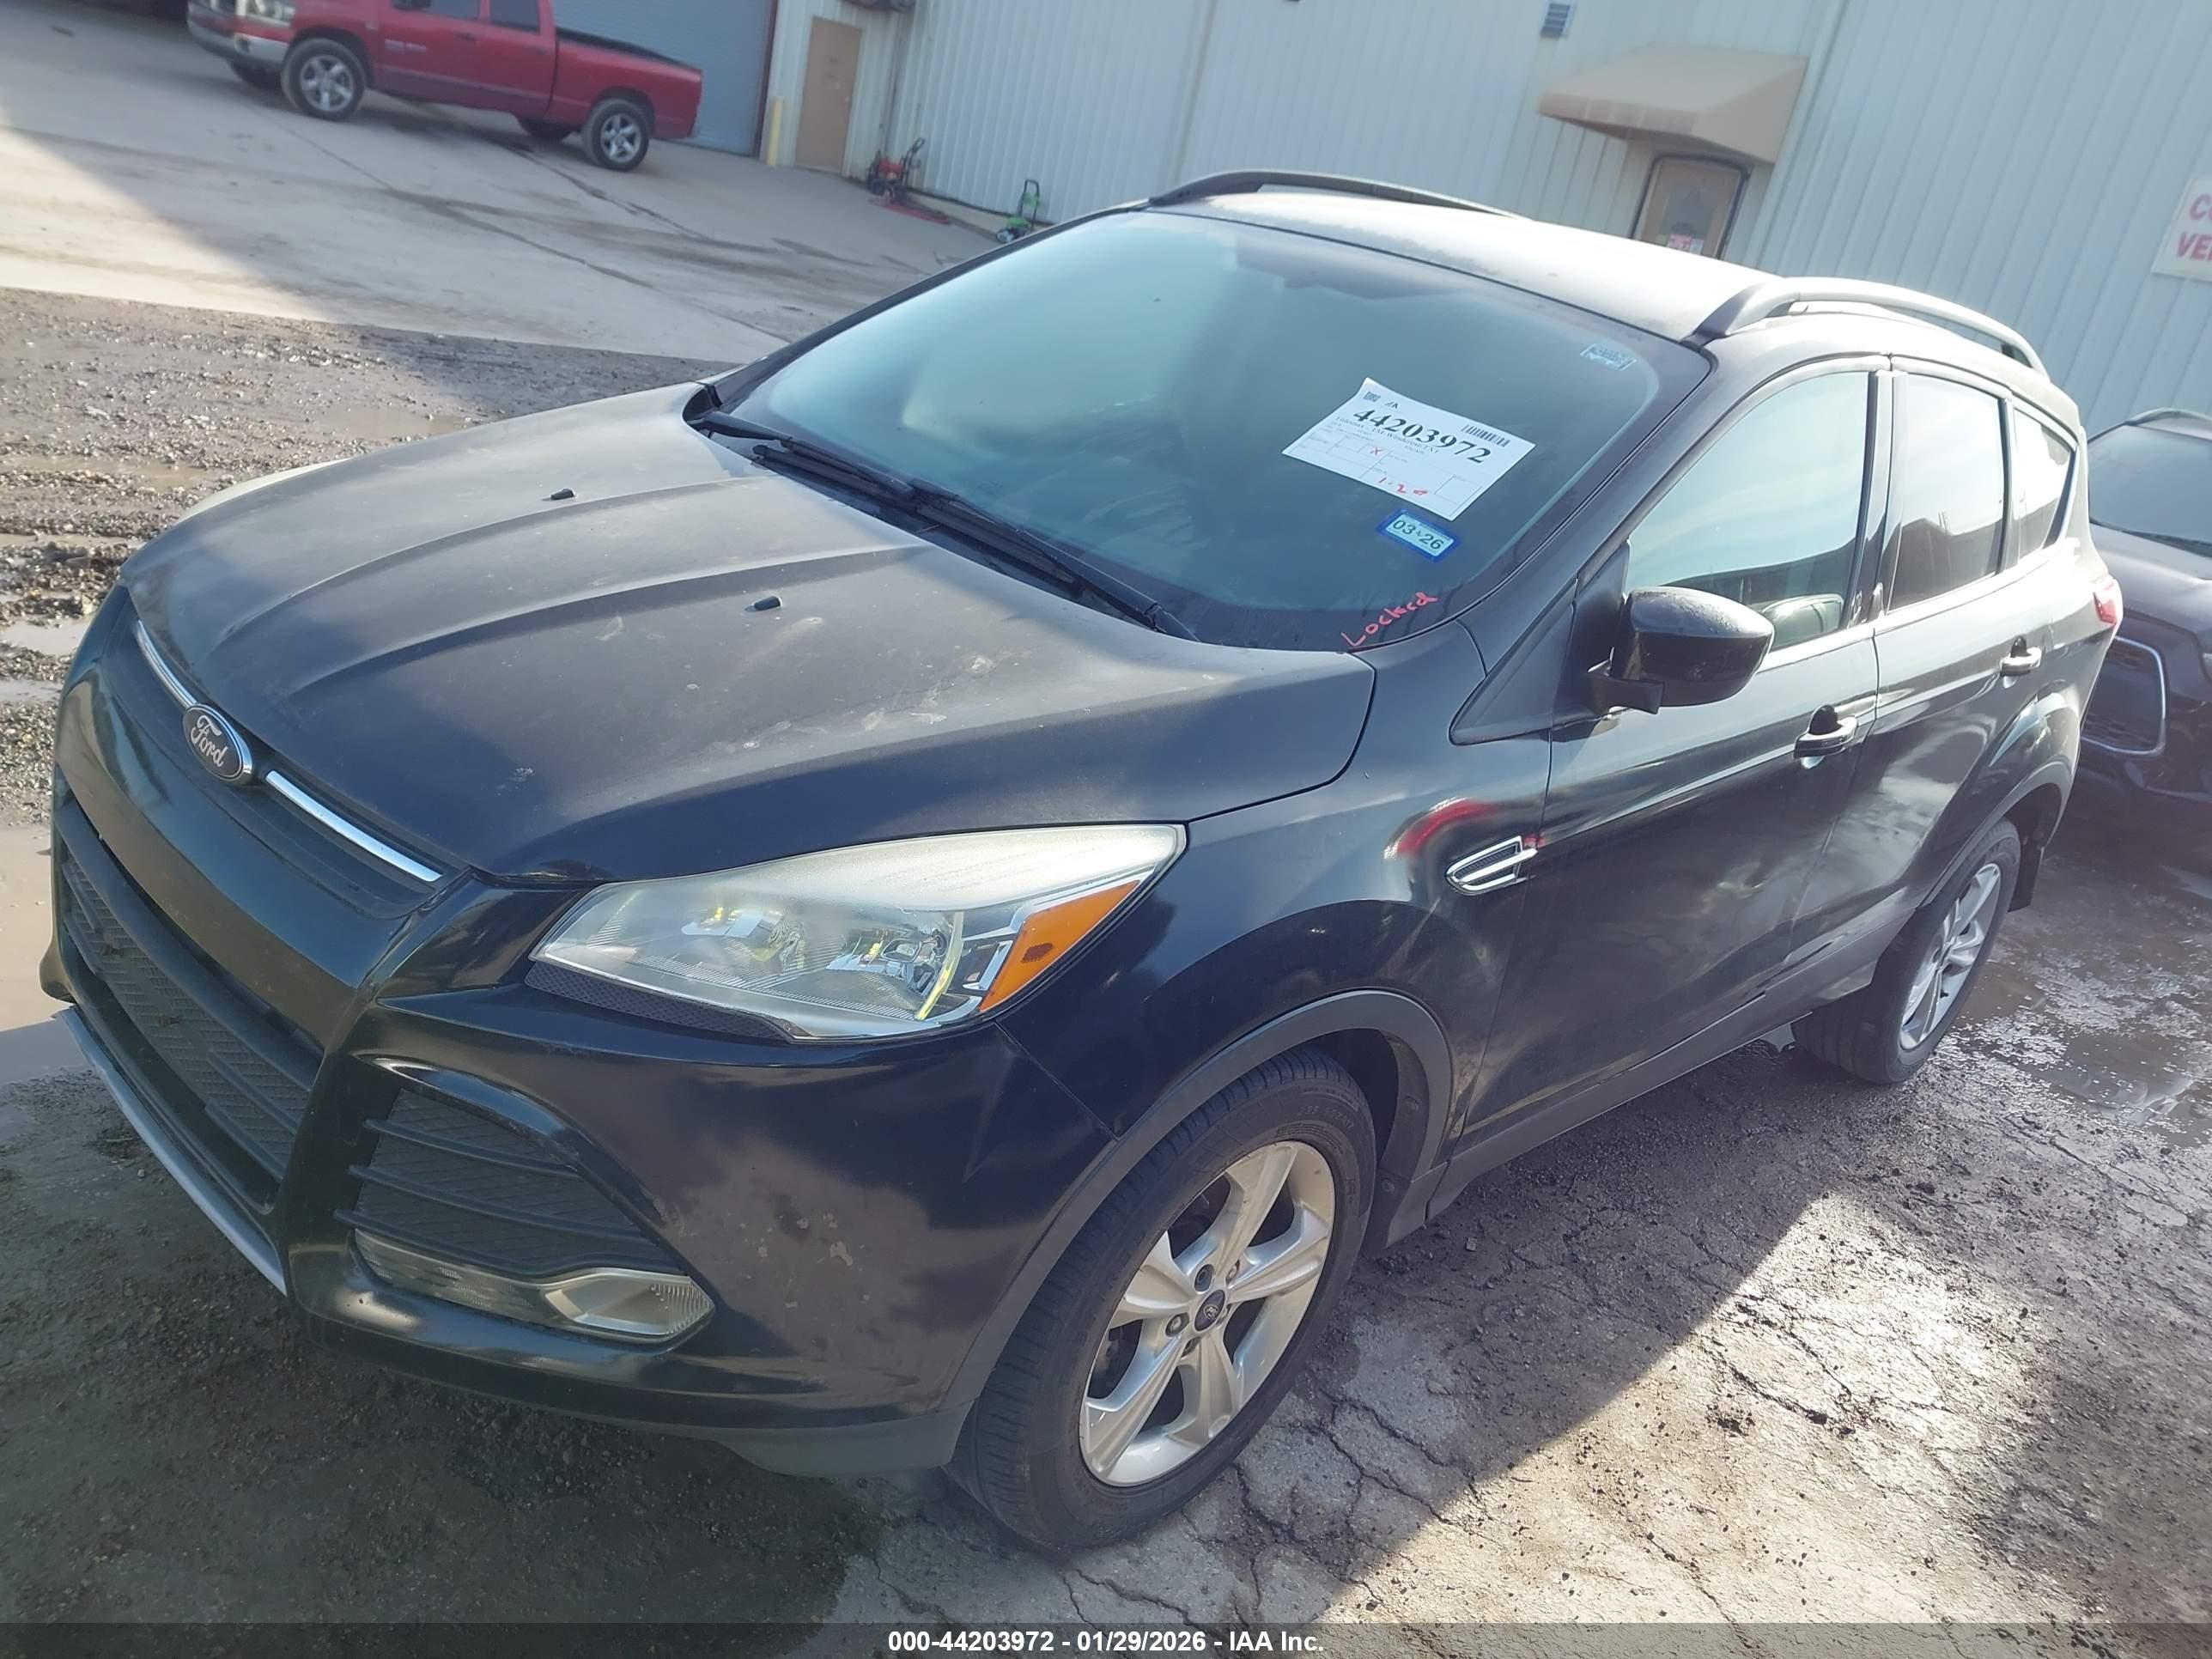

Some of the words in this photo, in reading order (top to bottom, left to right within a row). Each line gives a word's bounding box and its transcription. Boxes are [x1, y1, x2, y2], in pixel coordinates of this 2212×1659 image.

[2189, 194, 2212, 221] C
[2177, 231, 2212, 260] VE
[1353, 410, 1491, 463] 44203972
[191, 714, 228, 767] Ford
